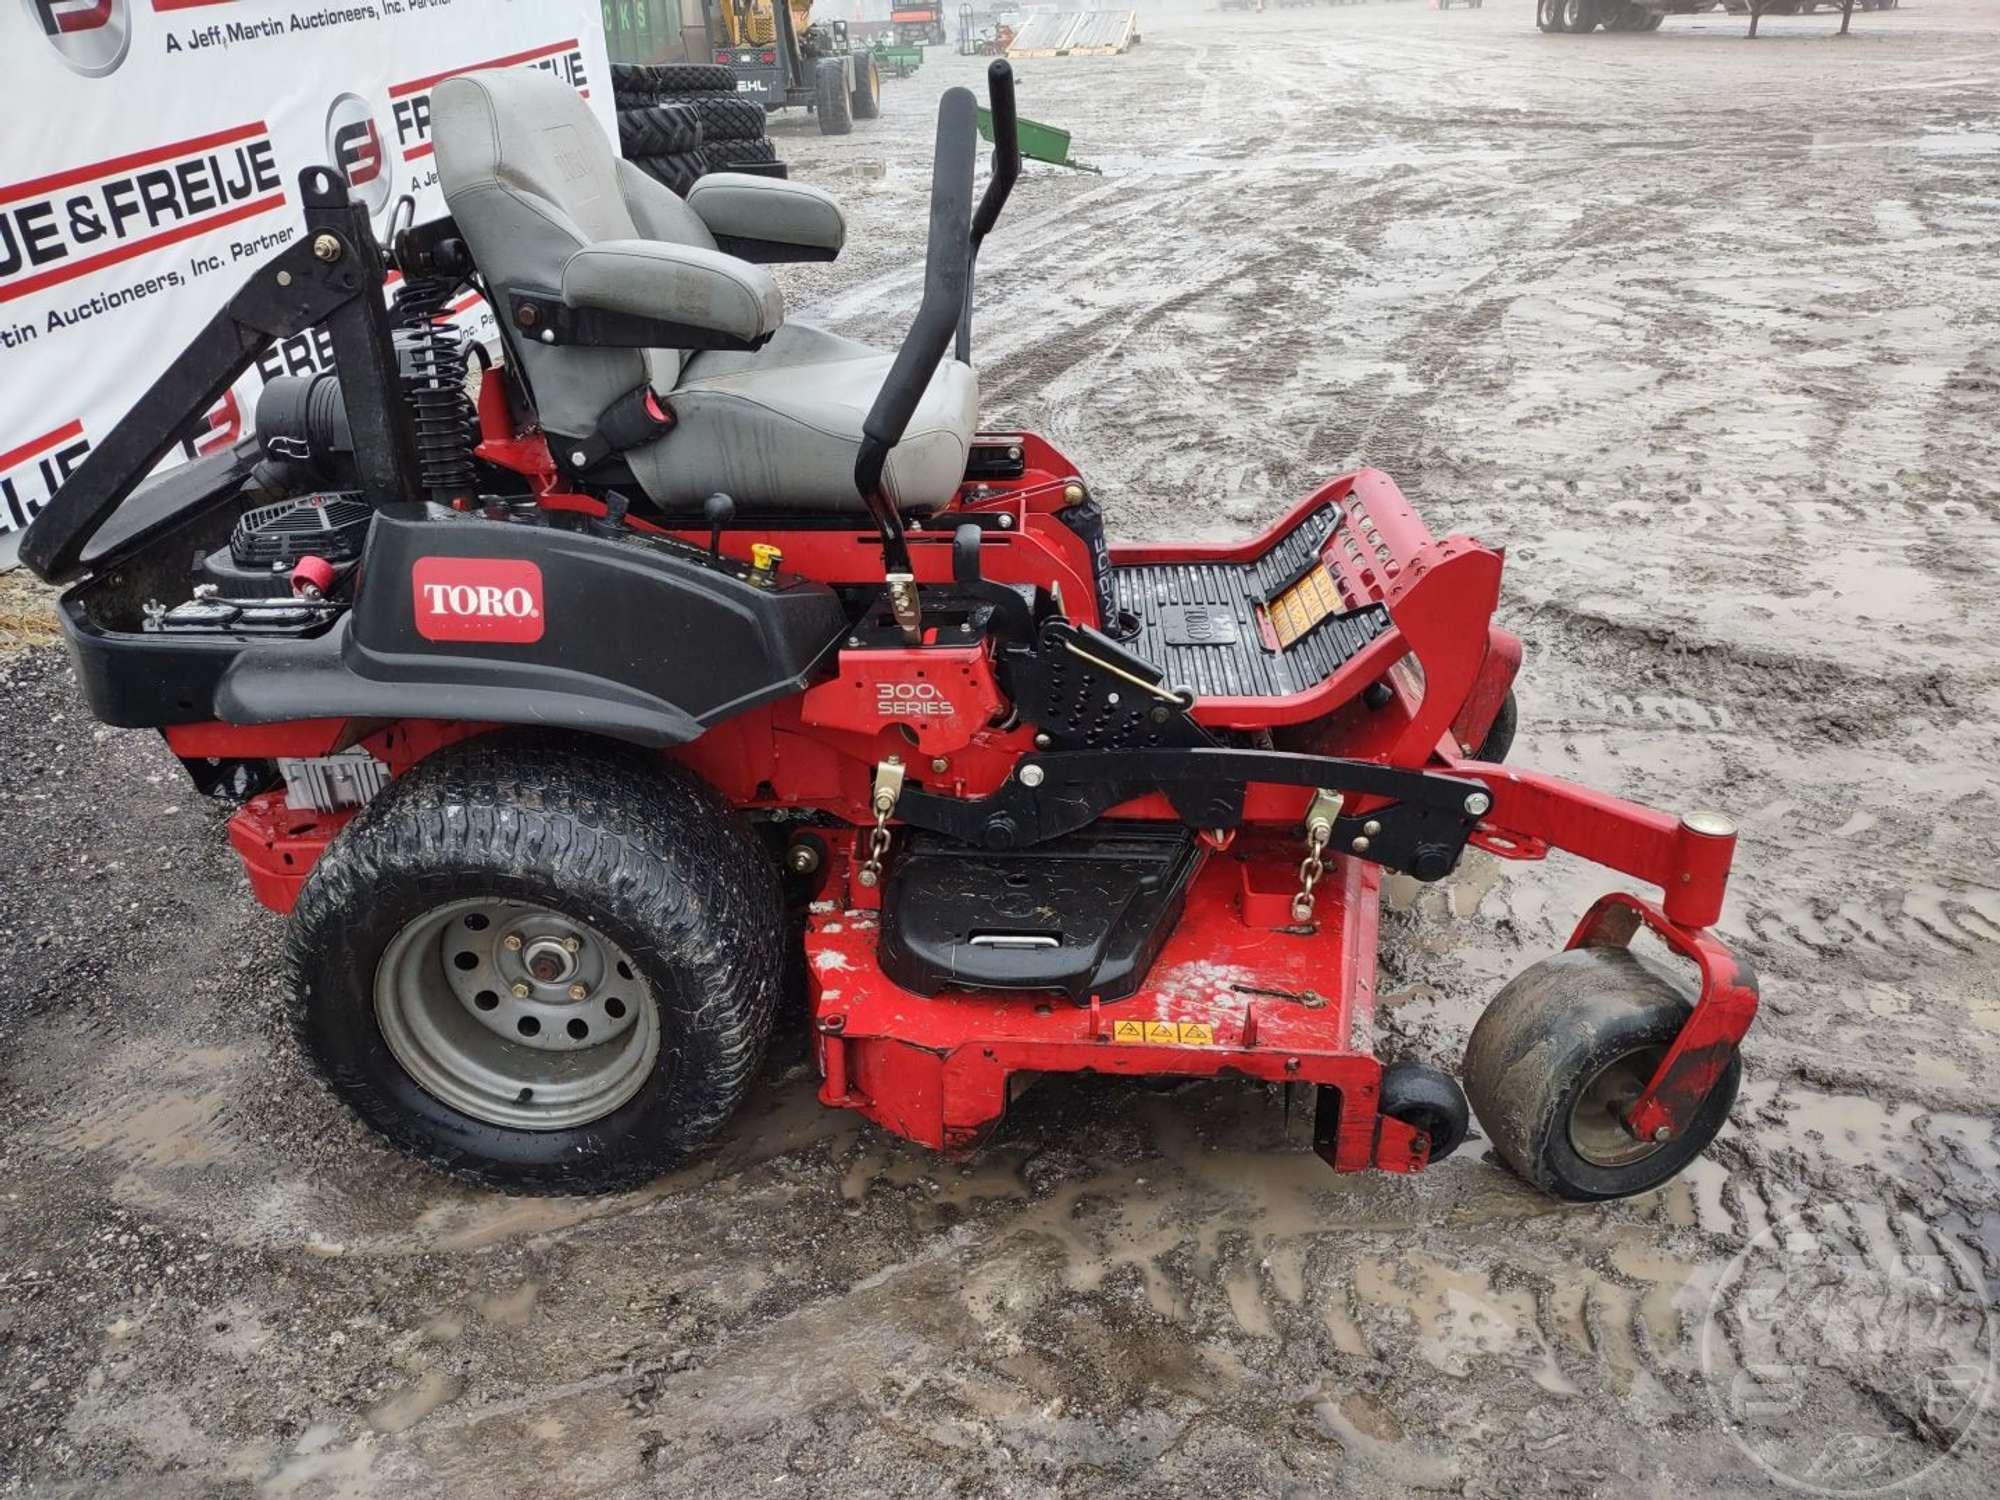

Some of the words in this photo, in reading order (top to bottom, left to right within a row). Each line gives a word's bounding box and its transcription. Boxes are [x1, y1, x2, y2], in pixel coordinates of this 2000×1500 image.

[166, 33, 182, 53] A
[225, 17, 285, 42] Martin
[290, 4, 380, 32] Auctioneers,
[47, 269, 186, 333] Auctioneers,
[191, 253, 226, 277] Inc.
[230, 226, 295, 261] Partner
[878, 701, 955, 715] SERIES
